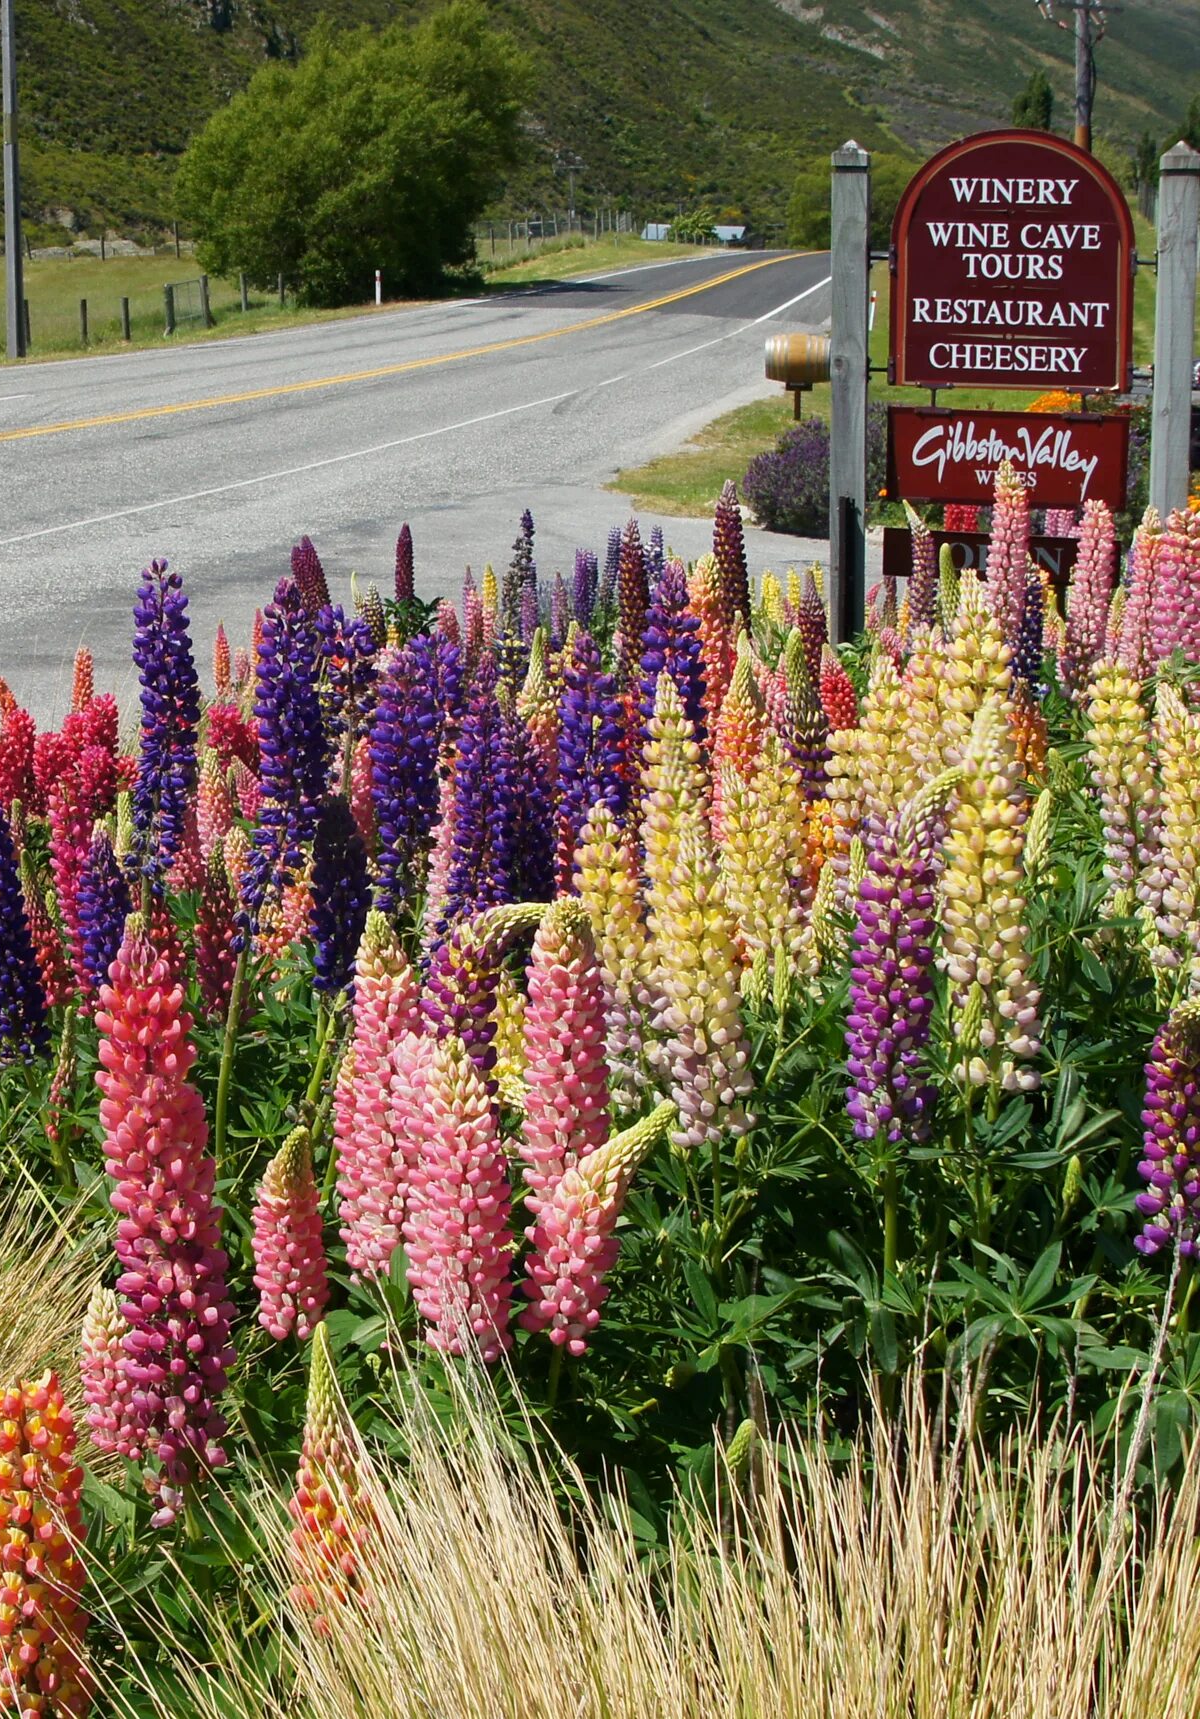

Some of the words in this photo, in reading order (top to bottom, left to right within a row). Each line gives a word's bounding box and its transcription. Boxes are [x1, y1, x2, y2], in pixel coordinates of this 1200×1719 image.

[949, 177, 1079, 206] WINERY
[926, 222, 1010, 249] WINE
[1020, 223, 1101, 250] CAVE
[962, 253, 1064, 281] TOURS
[912, 298, 1110, 328] RESTAURANT
[928, 342, 1088, 373] CHEESERY
[912, 421, 1026, 484] Gibbston
[1017, 426, 1099, 502] Valley
[974, 469, 1038, 488] WIES
